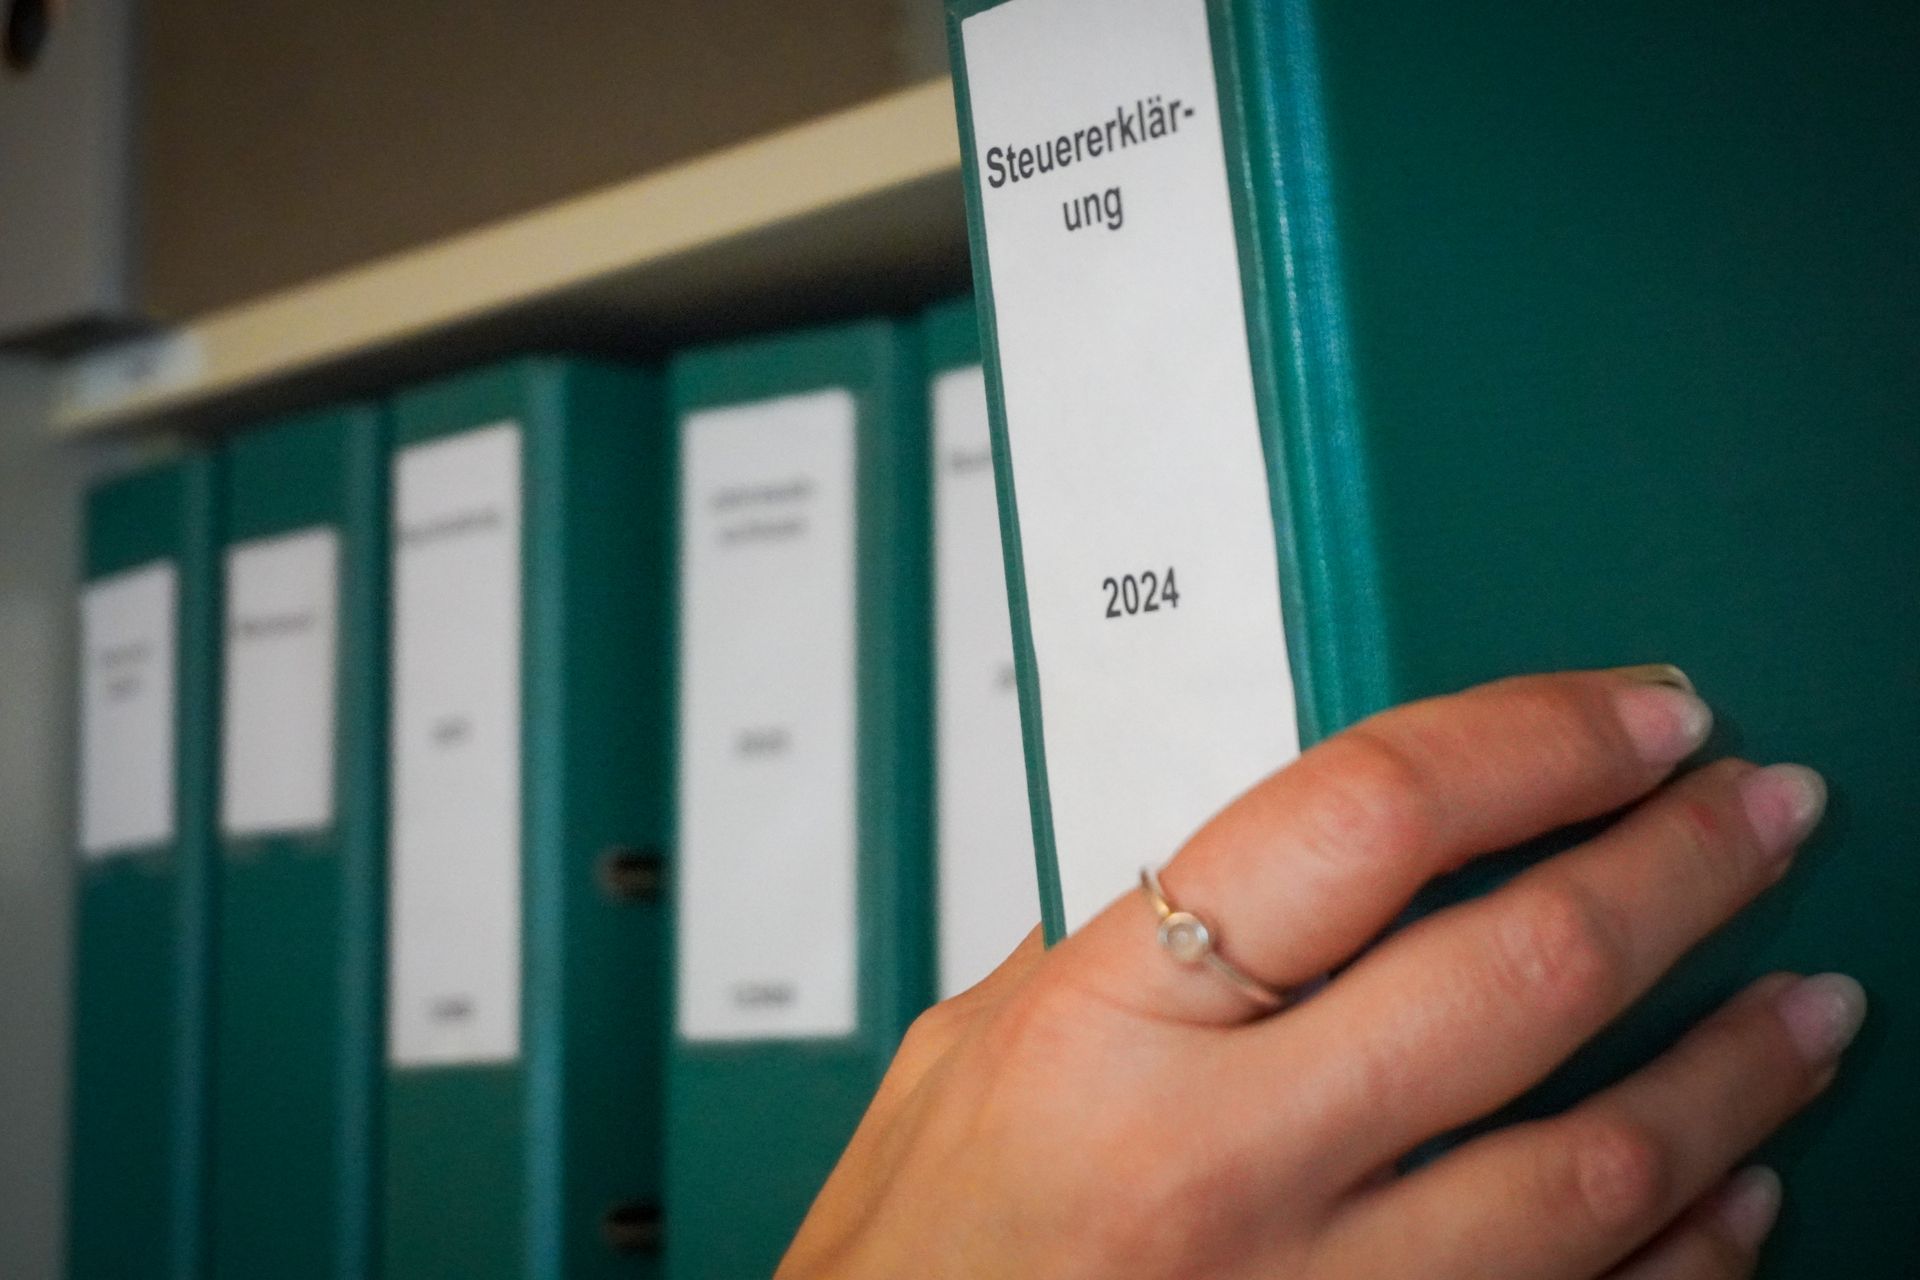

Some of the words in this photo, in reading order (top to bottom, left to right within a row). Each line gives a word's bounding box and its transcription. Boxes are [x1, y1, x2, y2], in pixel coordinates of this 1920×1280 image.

[986, 95, 1195, 189] Steuererklär-
[1062, 186, 1123, 231] ung
[1102, 566, 1180, 618] 2024
